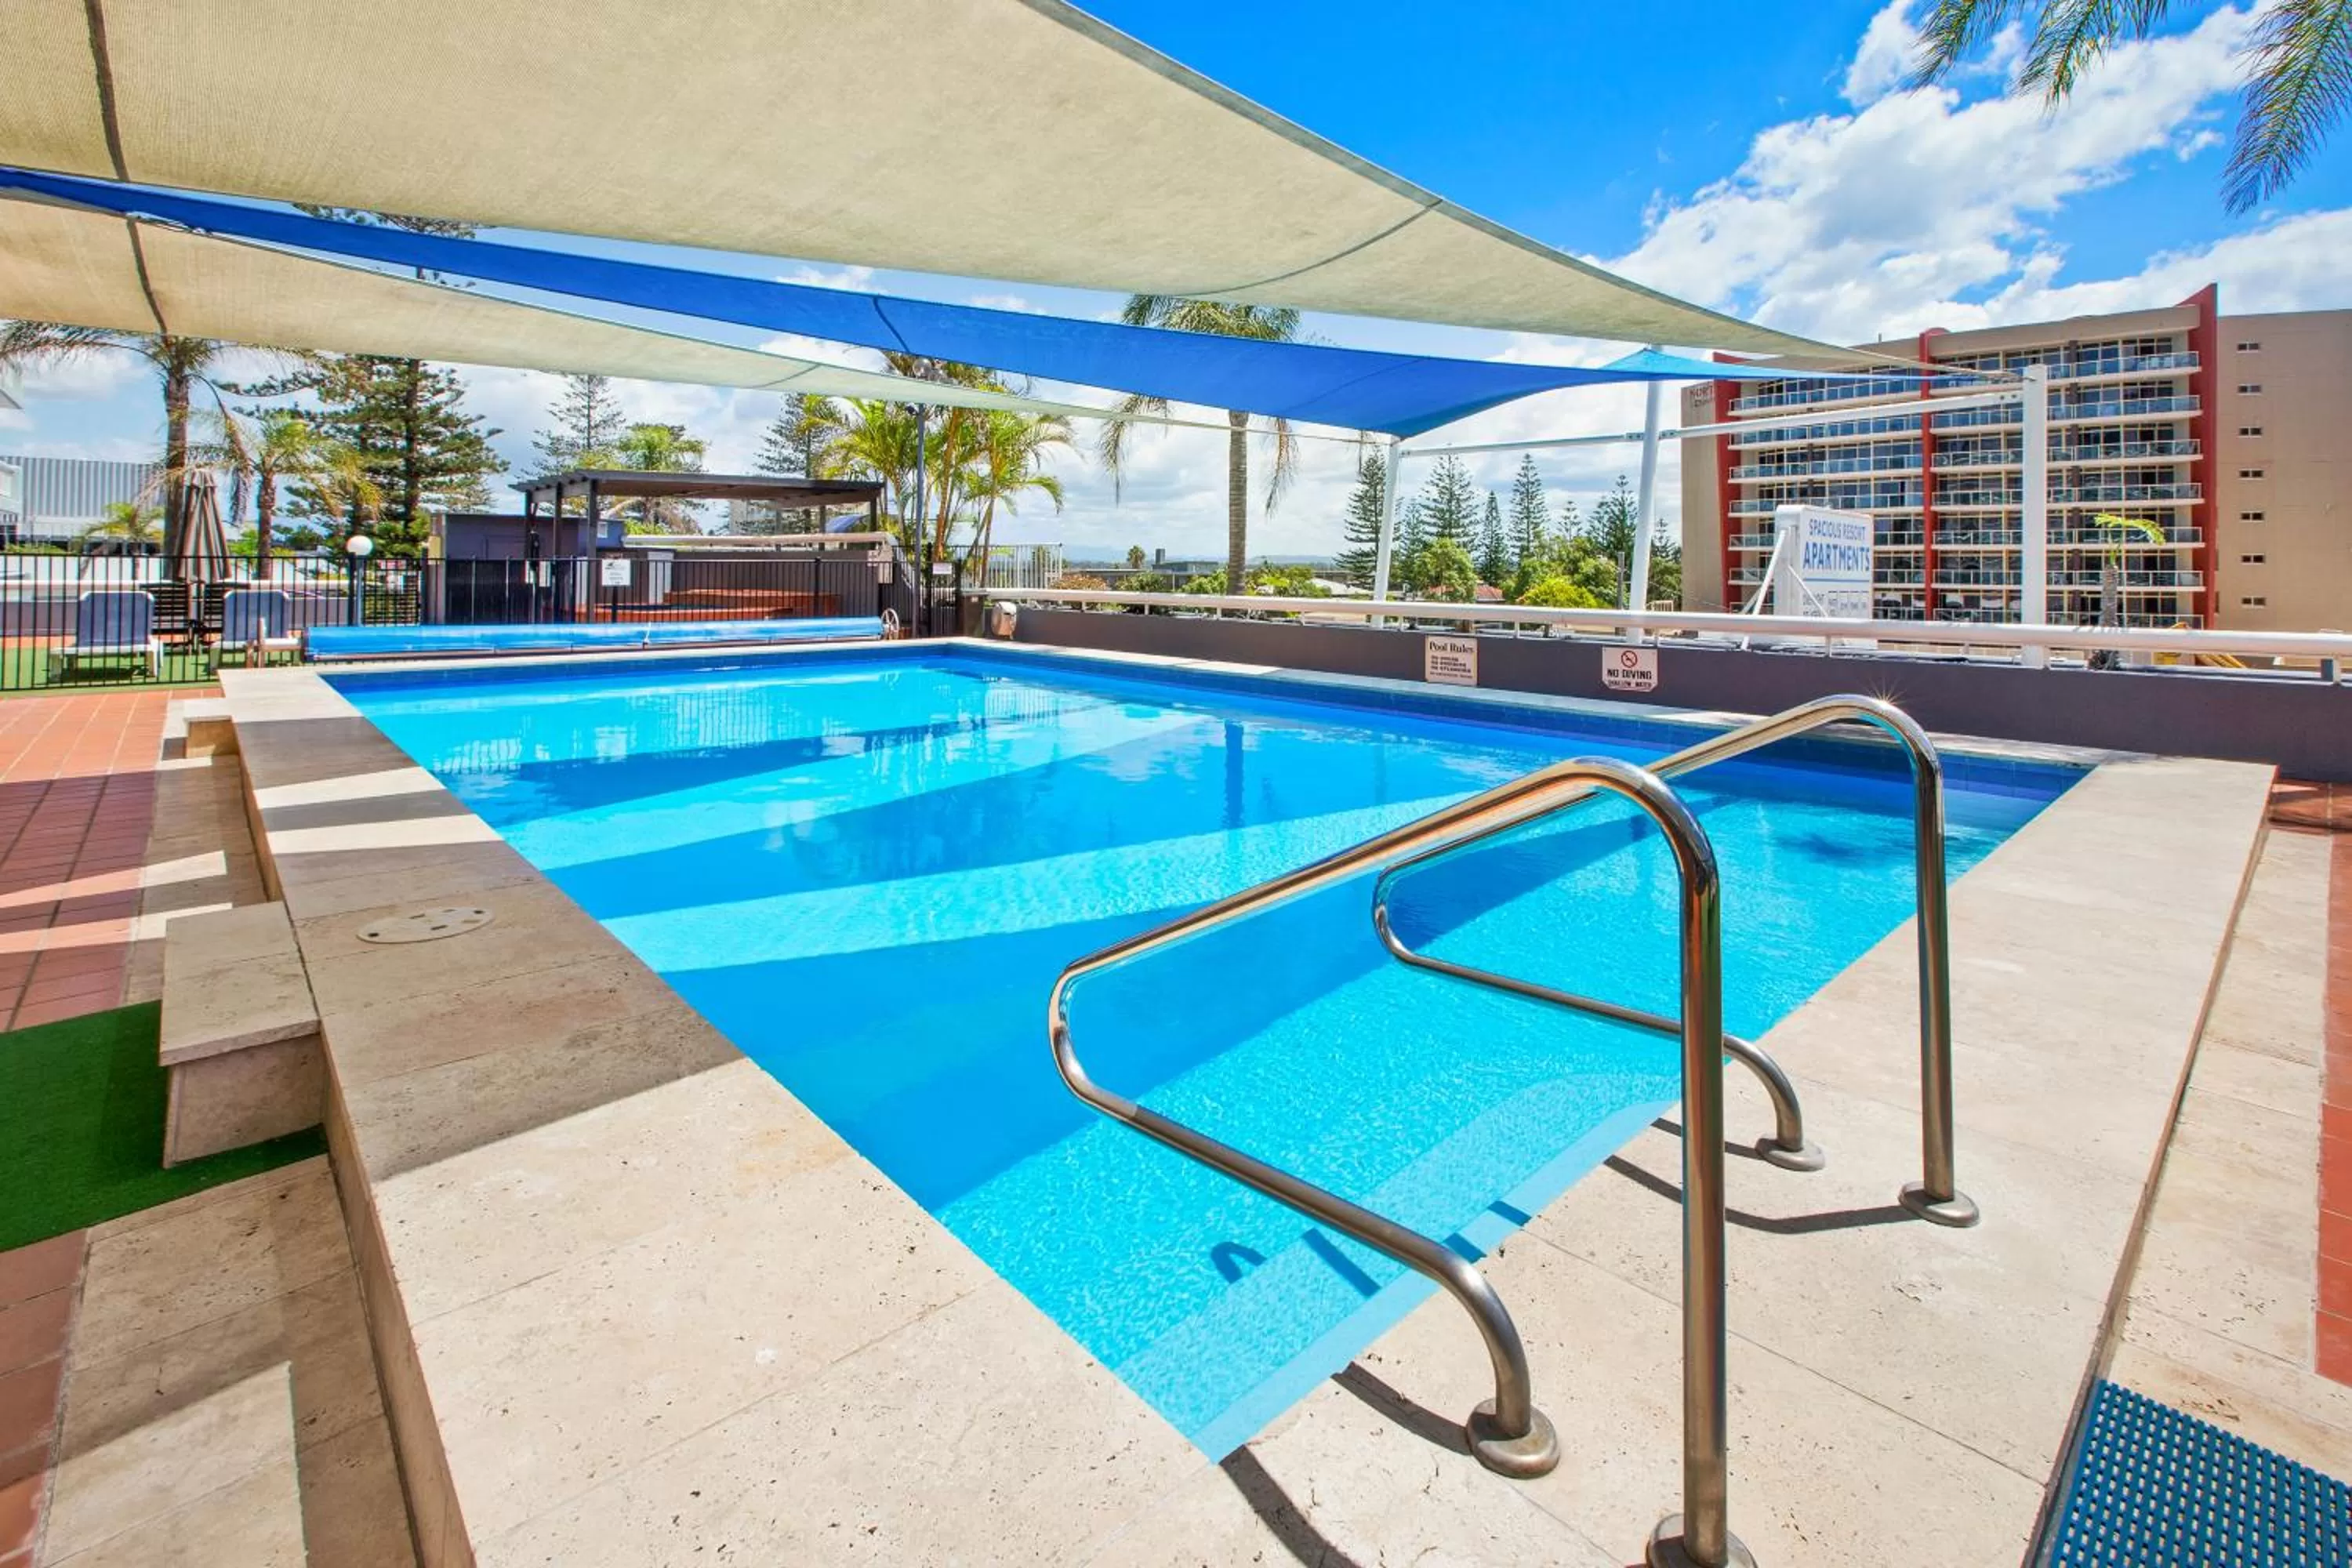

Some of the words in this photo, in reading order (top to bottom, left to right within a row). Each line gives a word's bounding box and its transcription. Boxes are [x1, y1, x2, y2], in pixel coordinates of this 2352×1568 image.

[1802, 541, 1870, 572] APARTMENTS
[1429, 641, 1448, 652] Pool
[1450, 642, 1474, 653] Rules
[1607, 669, 1619, 678] NO
[1622, 670, 1652, 680] DIVING
